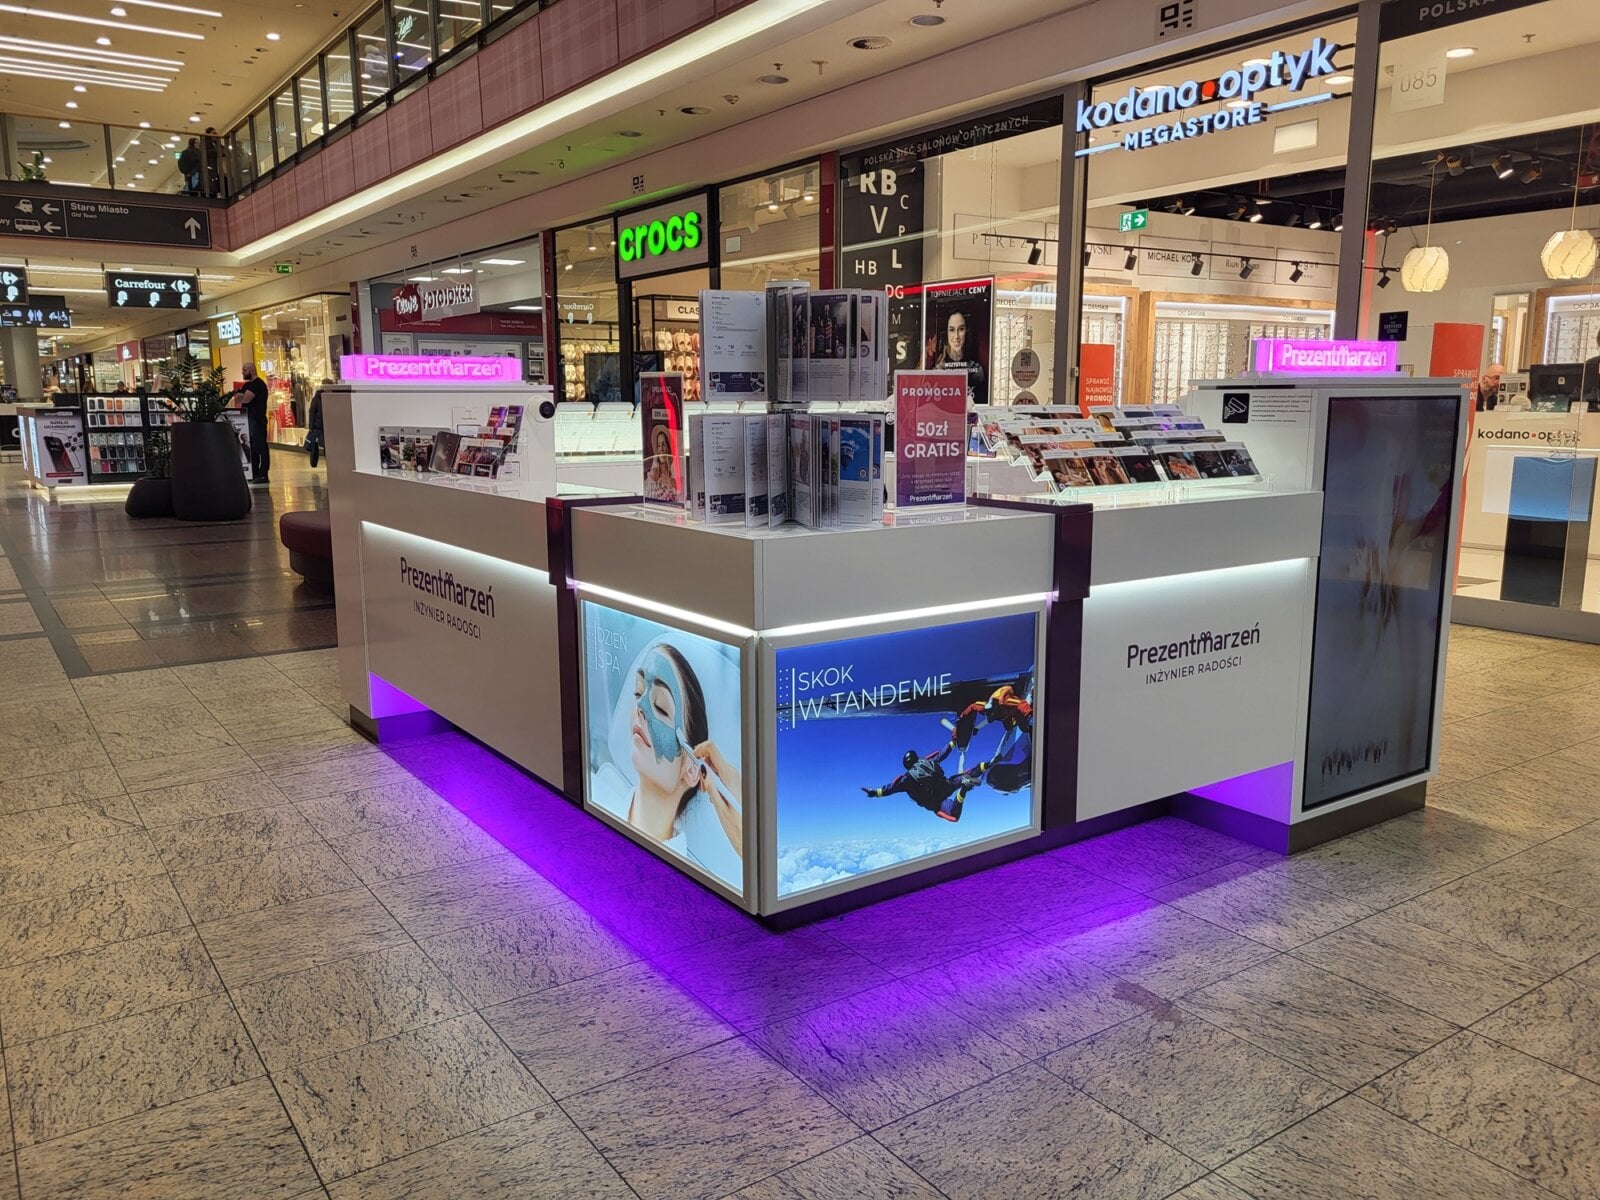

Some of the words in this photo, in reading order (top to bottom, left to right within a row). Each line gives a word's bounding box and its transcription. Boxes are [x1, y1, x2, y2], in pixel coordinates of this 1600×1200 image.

[1076, 79, 1201, 132] kodano
[1218, 37, 1338, 101] optyk
[1124, 102, 1264, 152] MEGASTORE
[864, 151, 894, 167] POLSKA
[917, 134, 960, 153] SALONÓW
[963, 115, 1029, 141] OPTYCZNYCH
[71, 202, 96, 212] Stare
[98, 204, 130, 215] Miasto
[619, 211, 700, 262] crocs
[1147, 251, 1180, 263] MICHAEL
[114, 278, 167, 290] Carrefour
[968, 285, 987, 295] CENY
[902, 386, 962, 398] PROMOCJA
[916, 420, 949, 438] 50zł
[1477, 428, 1531, 440] kodano
[904, 441, 960, 459] GRATIS
[413, 599, 446, 624] INŻYNIER
[446, 613, 482, 641] RADOŚCI
[597, 626, 628, 652] DZIEŃ
[597, 649, 621, 676] SPA
[1145, 664, 1195, 685] INŻYNIER
[1197, 655, 1243, 675] RADOŚCI
[798, 664, 855, 692] SKOK
[798, 695, 825, 721] W
[830, 672, 952, 715] TANDEMIE
